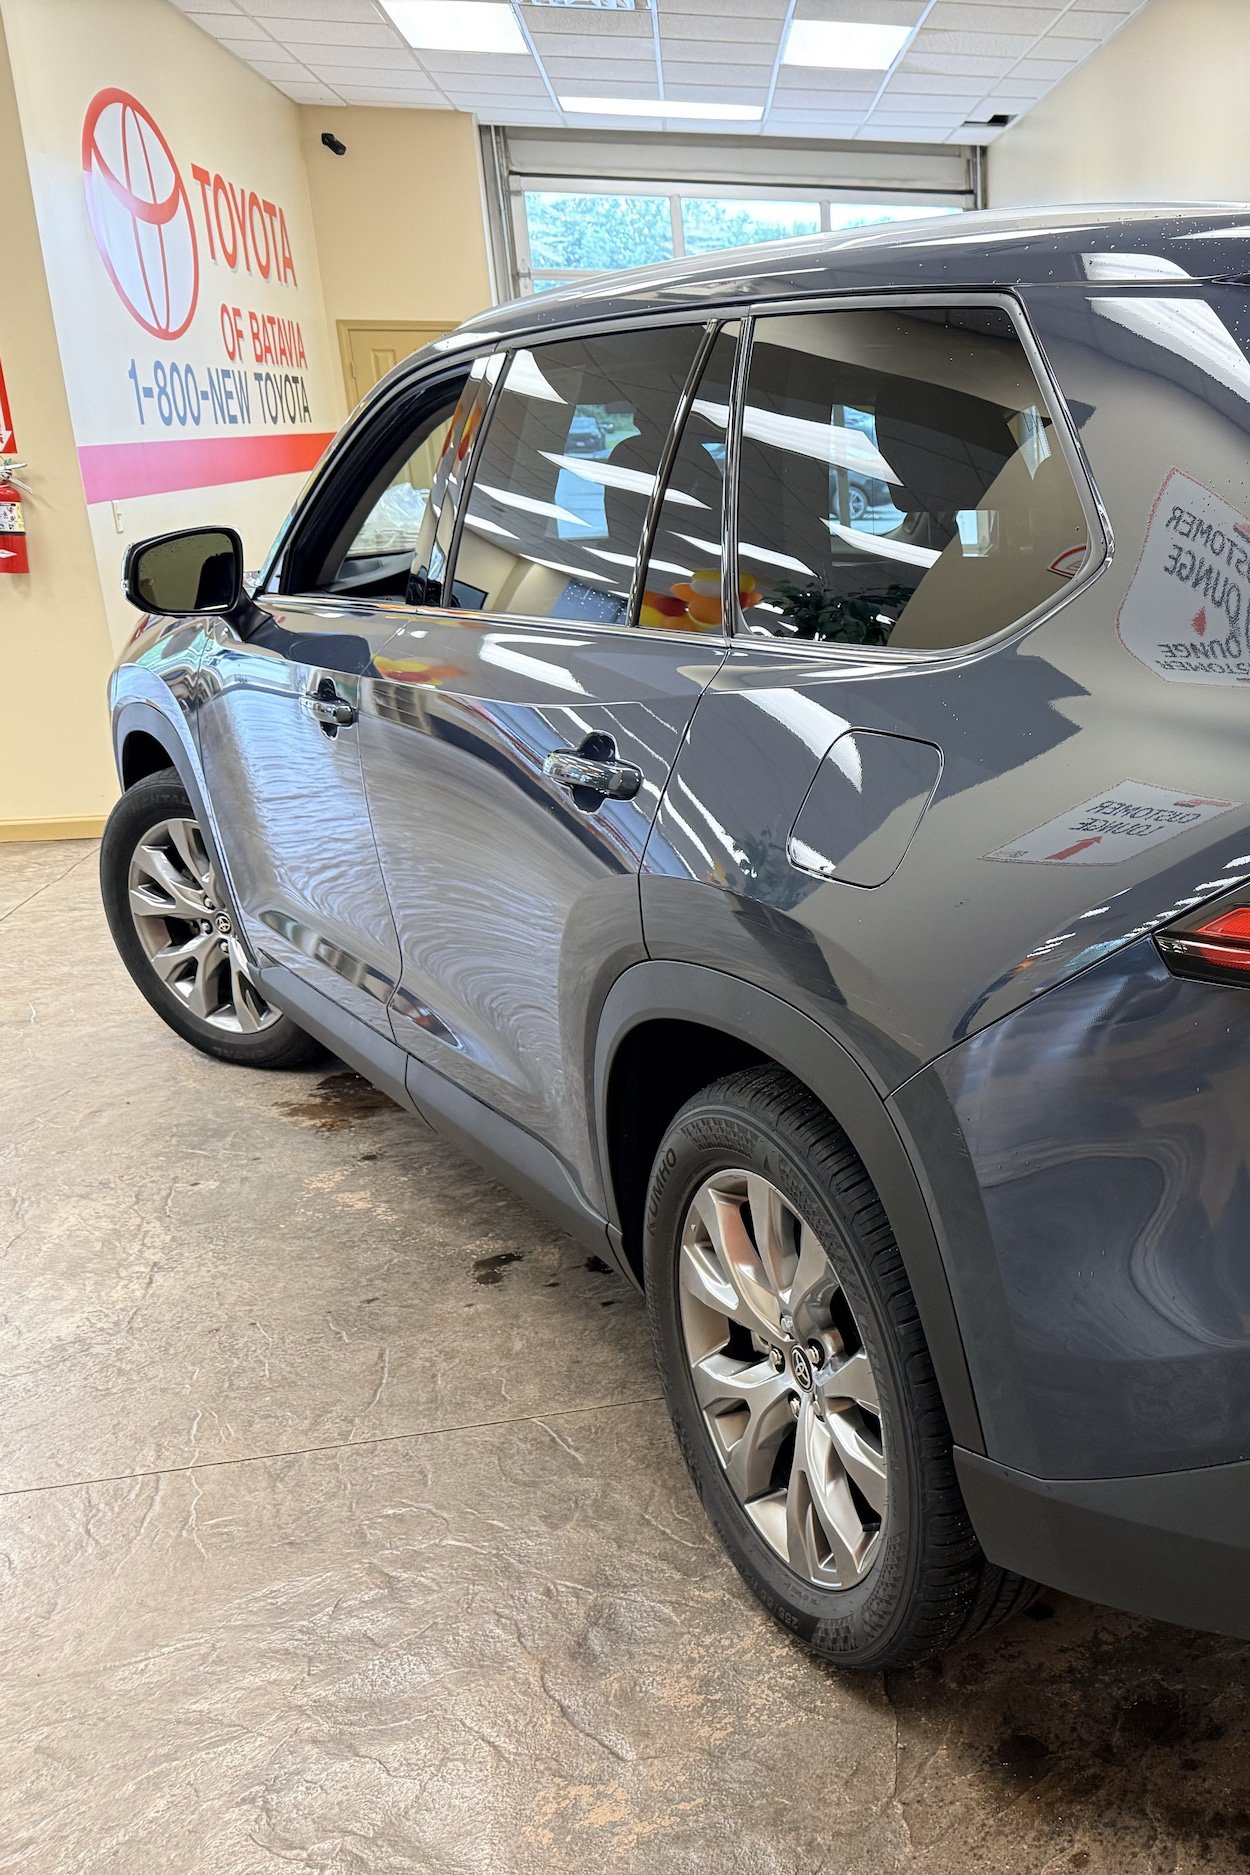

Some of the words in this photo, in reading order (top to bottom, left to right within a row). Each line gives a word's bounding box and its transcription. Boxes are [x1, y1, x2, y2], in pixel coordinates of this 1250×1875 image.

[190, 163, 299, 287] TOYOTA
[220, 303, 244, 362] OF
[248, 311, 308, 369] BATAVIA
[254, 372, 313, 424] TOYOTA
[647, 1148, 677, 1238] KUMHO
